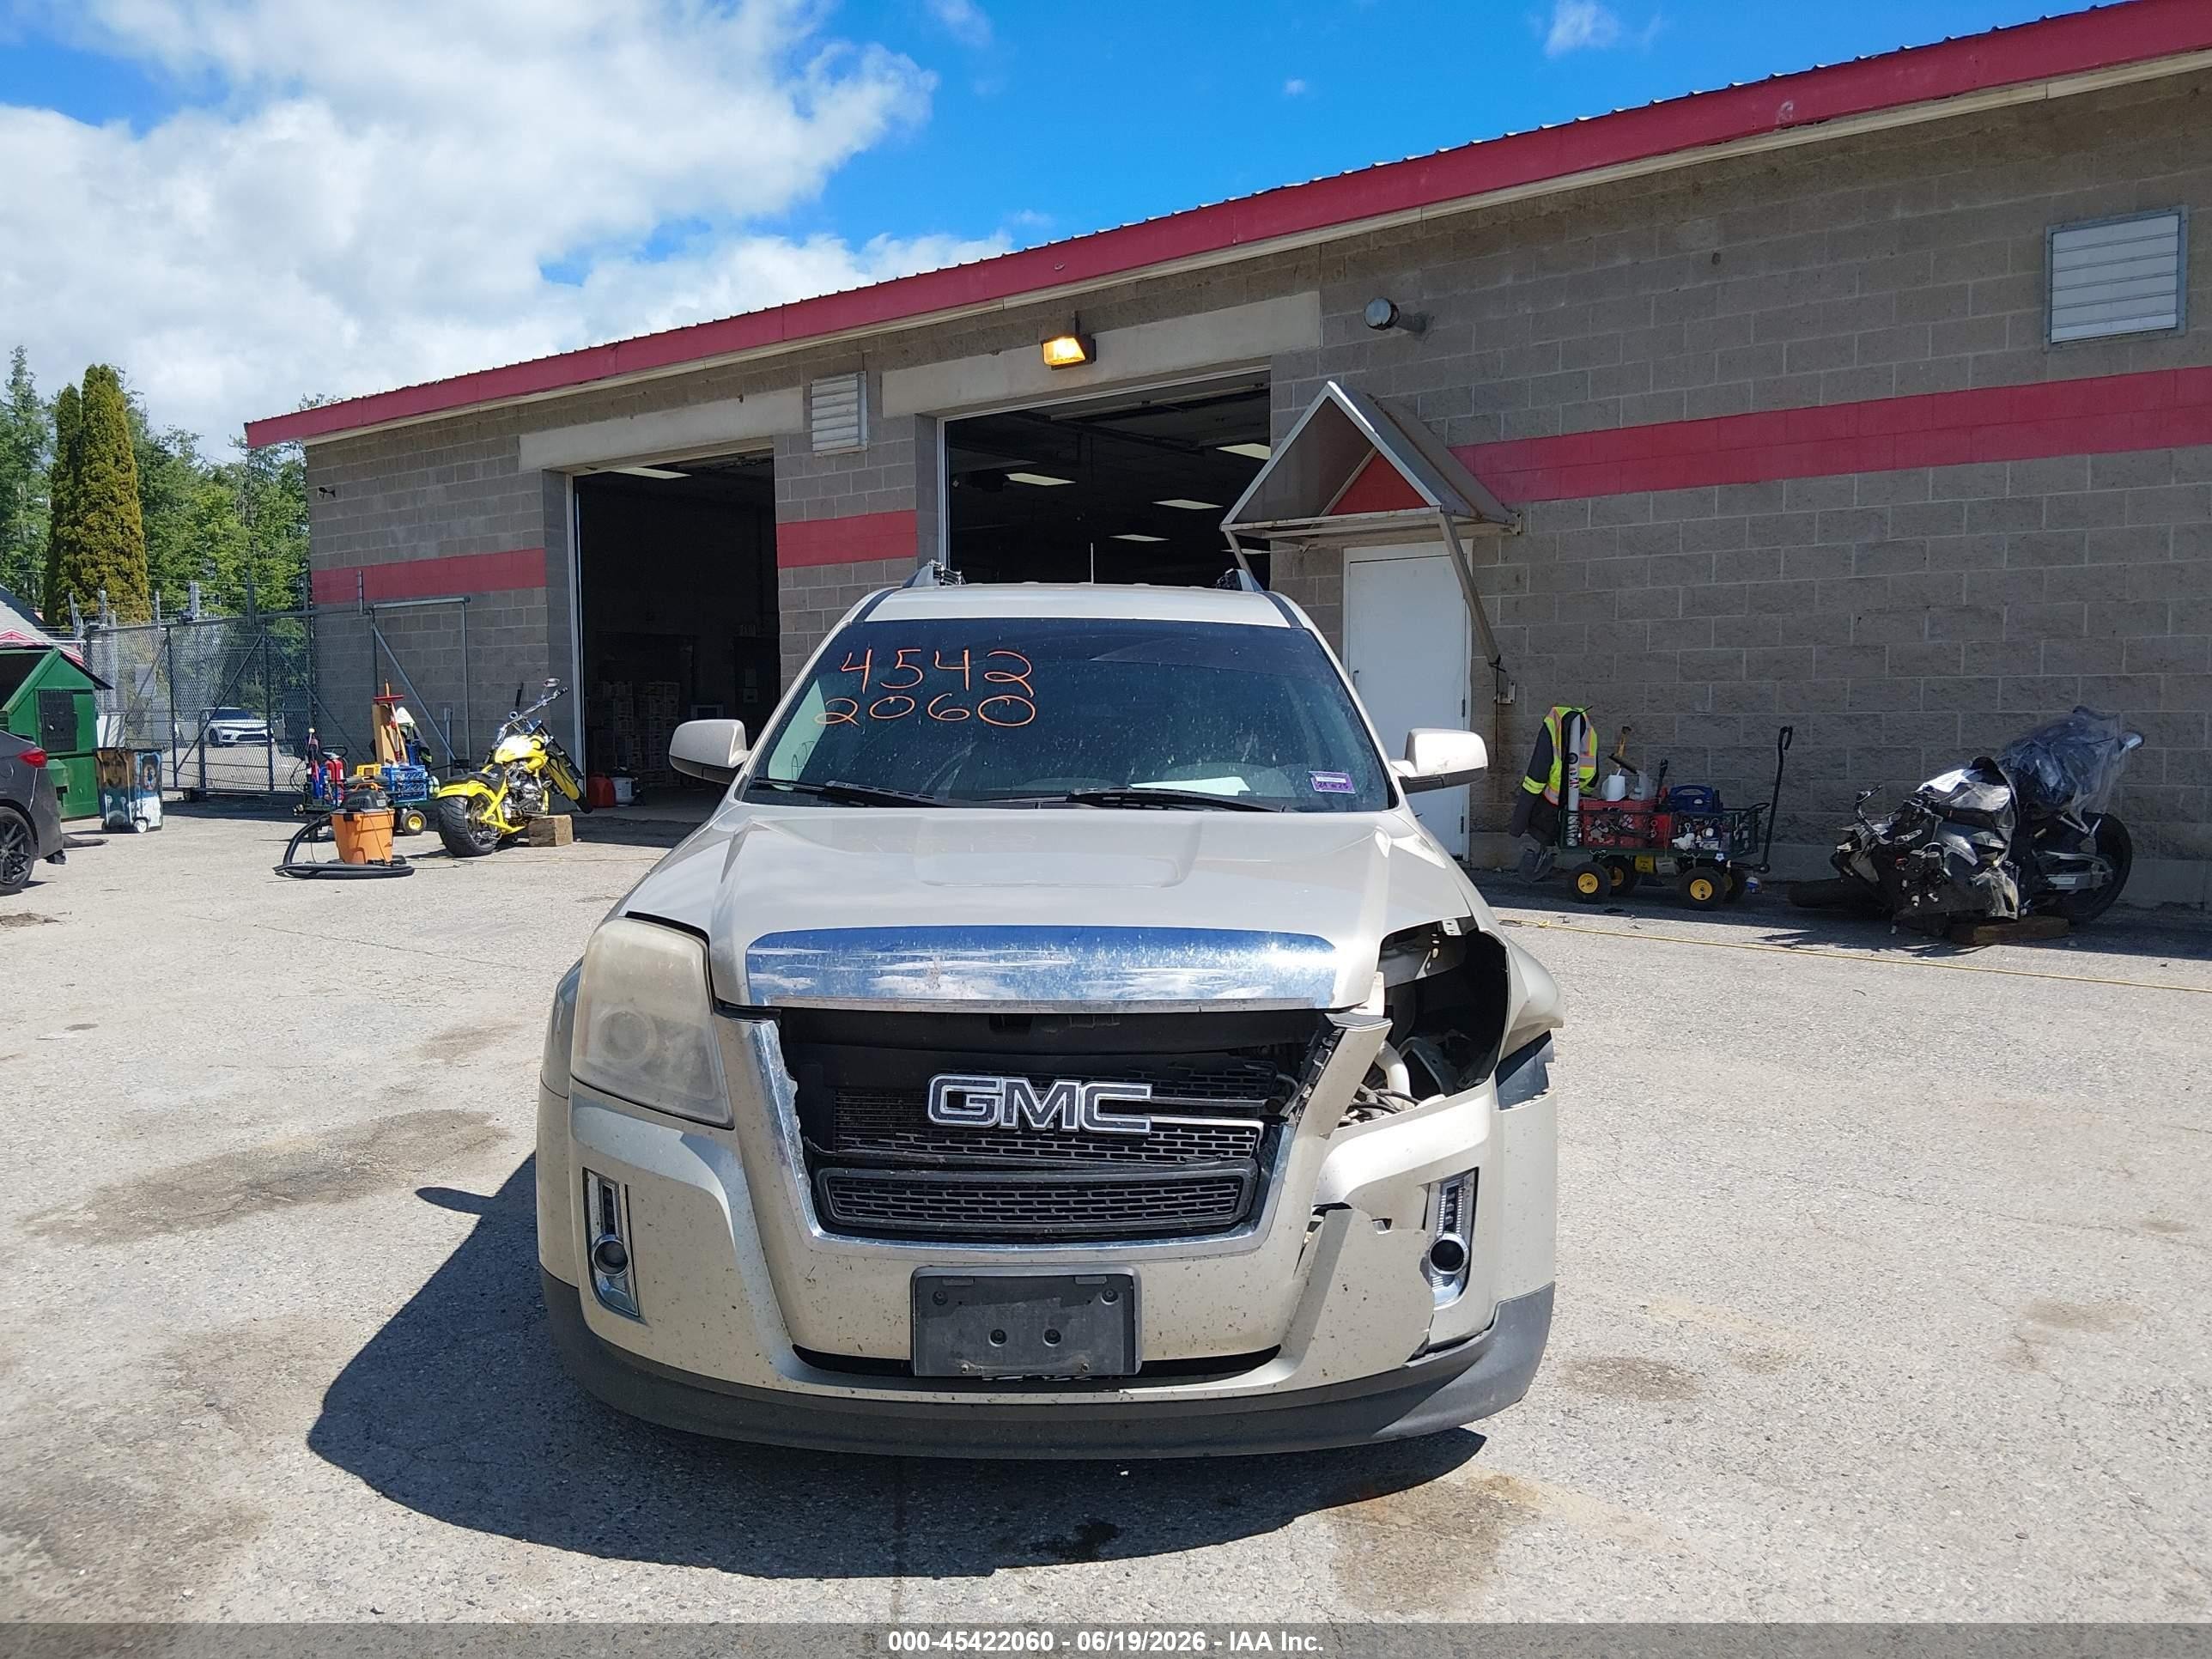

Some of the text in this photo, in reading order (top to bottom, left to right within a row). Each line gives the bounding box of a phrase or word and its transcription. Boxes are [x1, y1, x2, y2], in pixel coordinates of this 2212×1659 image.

[840, 647, 1035, 698] 4542
[813, 692, 1036, 727] 2060
[927, 1073, 1152, 1134] GMC
